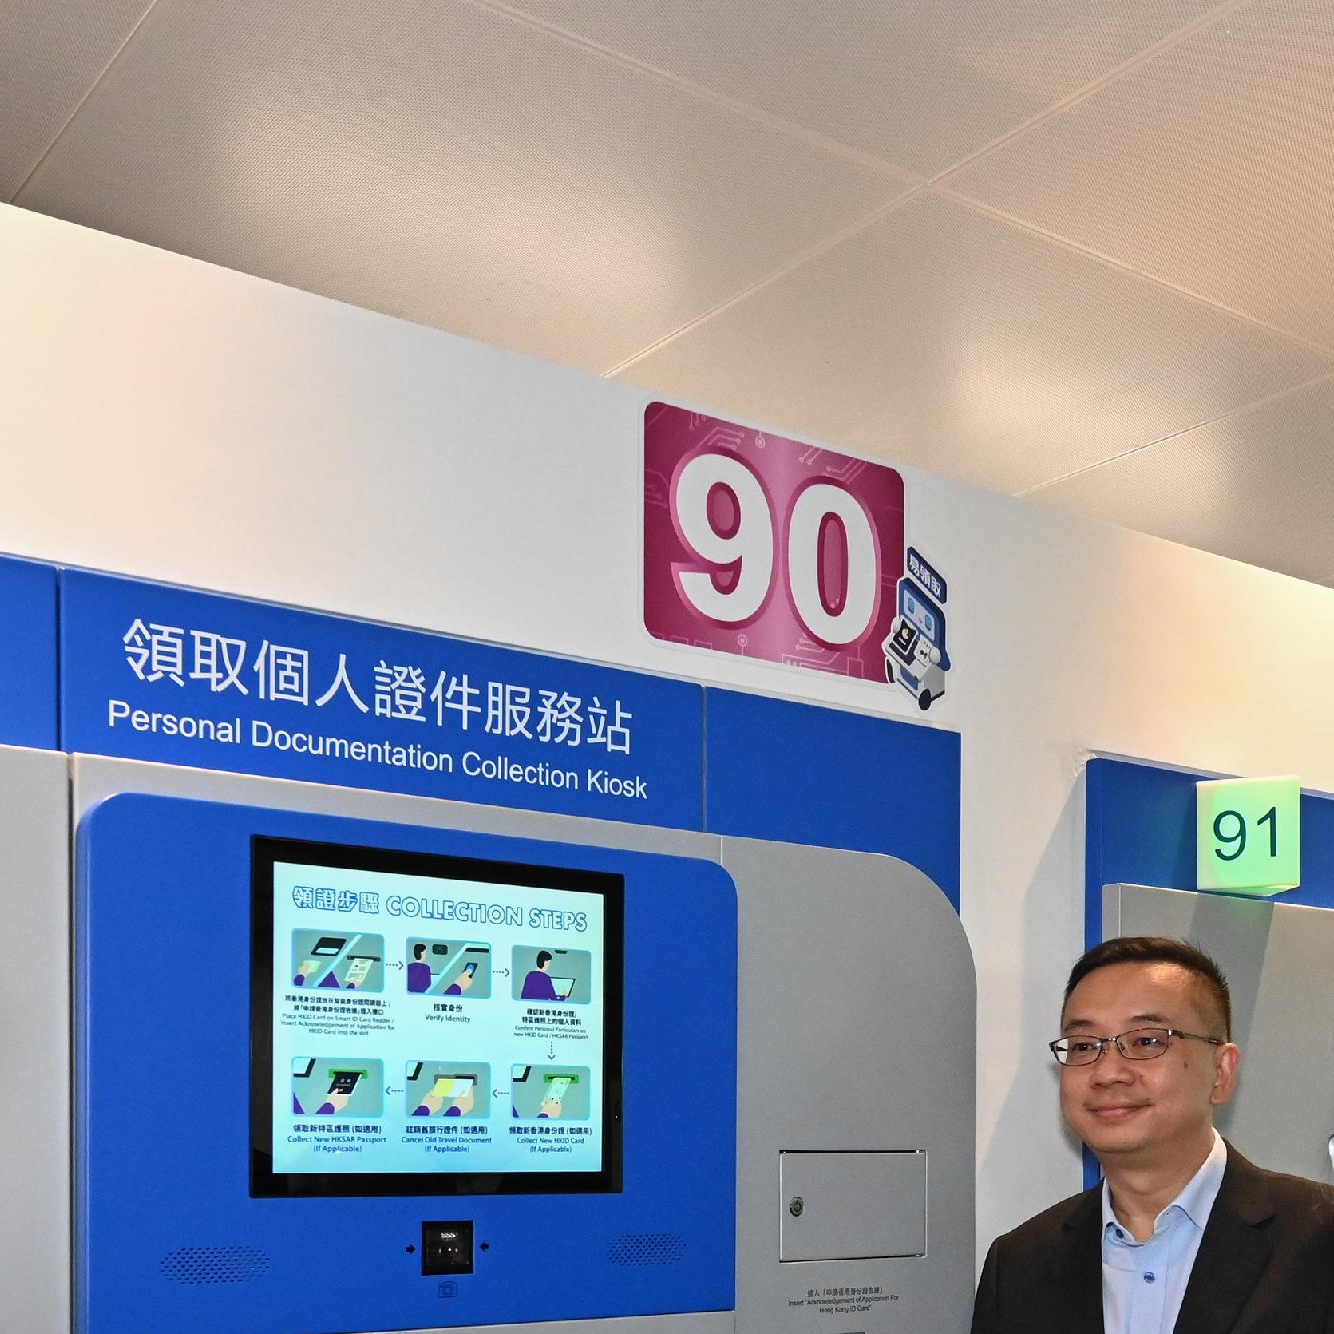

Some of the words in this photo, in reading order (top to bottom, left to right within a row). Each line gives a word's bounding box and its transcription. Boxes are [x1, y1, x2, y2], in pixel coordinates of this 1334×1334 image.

[676, 454, 877, 645] 90
[123, 618, 634, 756] 領取個人證件服務站
[108, 699, 242, 744] Personal
[252, 721, 454, 774] Documentation
[462, 751, 580, 791] Collection
[587, 769, 649, 800] Kiosk
[1213, 806, 1277, 861] 91
[292, 885, 380, 915] 領證步驟
[386, 895, 523, 927] COLLECTION
[529, 908, 588, 933] STEPS
[425, 1014, 444, 1023] Verify
[445, 1015, 471, 1024] Identity
[287, 1135, 312, 1143] Collect
[357, 1136, 387, 1145] Passport
[401, 1136, 424, 1144] Cancel
[425, 1136, 437, 1144] Old
[438, 1136, 458, 1144] Travel
[516, 1137, 539, 1145] Collect
[322, 1145, 363, 1153] Applicable)
[433, 1145, 470, 1153] Applicable)
[537, 1146, 573, 1154] Applicable)
[890, 1294, 900, 1302] For
